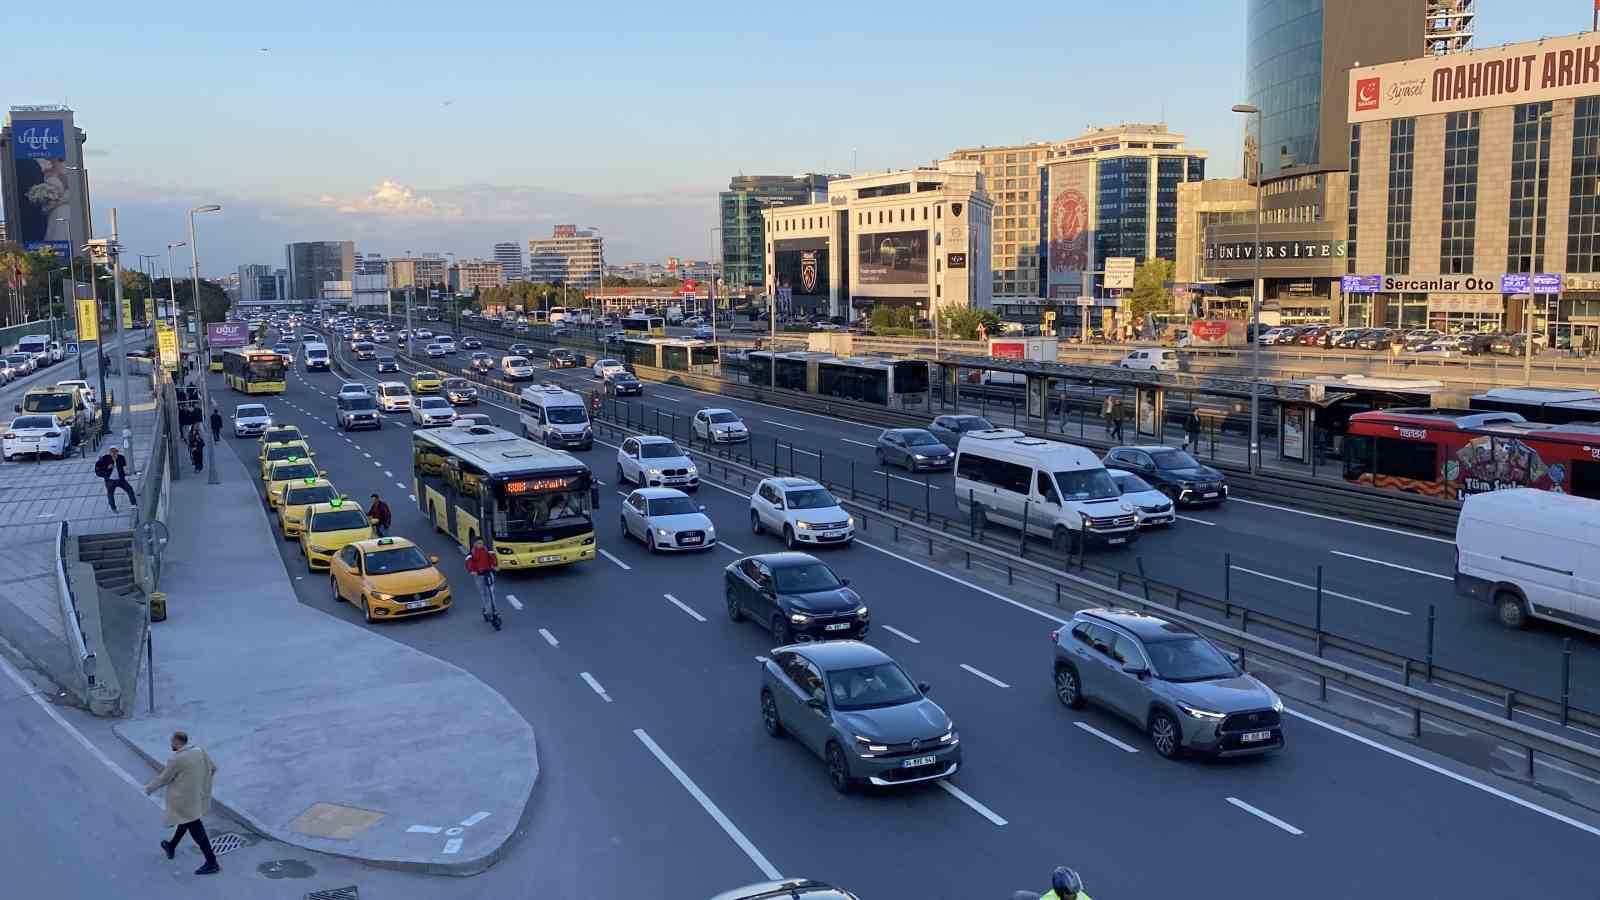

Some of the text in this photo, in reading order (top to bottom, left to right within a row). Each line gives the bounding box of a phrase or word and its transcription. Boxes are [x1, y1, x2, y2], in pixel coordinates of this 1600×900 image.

[1432, 55, 1536, 102] MAHMUT
[1385, 278, 1459, 290] Sercanlar
[1465, 278, 1494, 290] Oto
